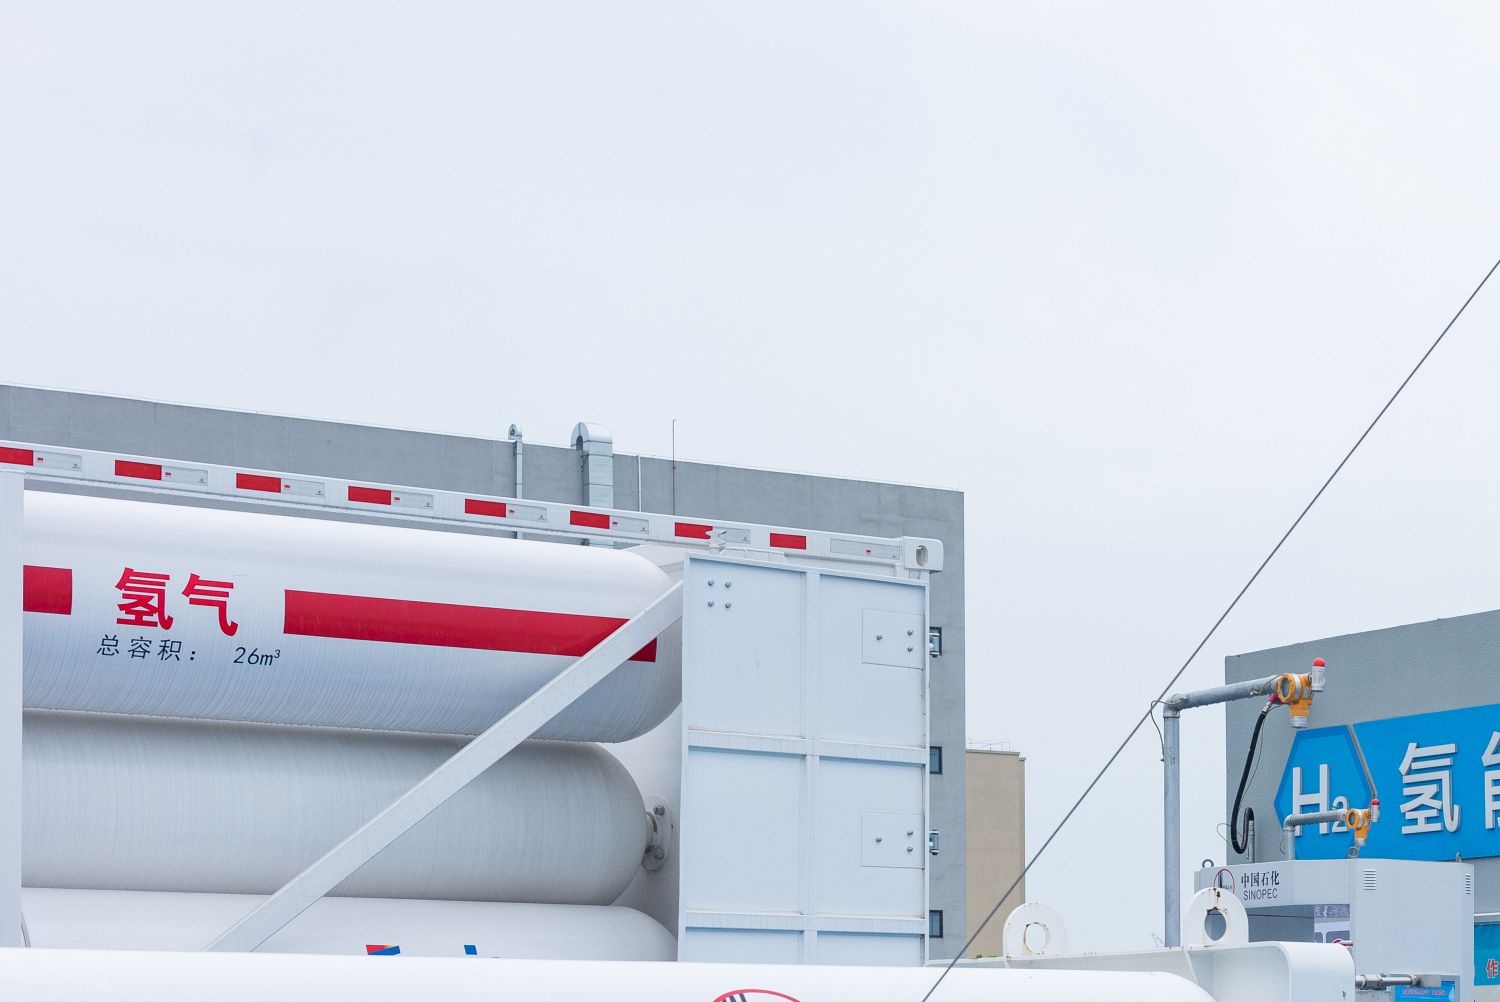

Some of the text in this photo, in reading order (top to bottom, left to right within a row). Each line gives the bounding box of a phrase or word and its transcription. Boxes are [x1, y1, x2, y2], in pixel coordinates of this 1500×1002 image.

[114, 566, 239, 637] 氢气
[1241, 870, 1280, 888] 中国石化
[1243, 888, 1278, 901] SINOPEC
